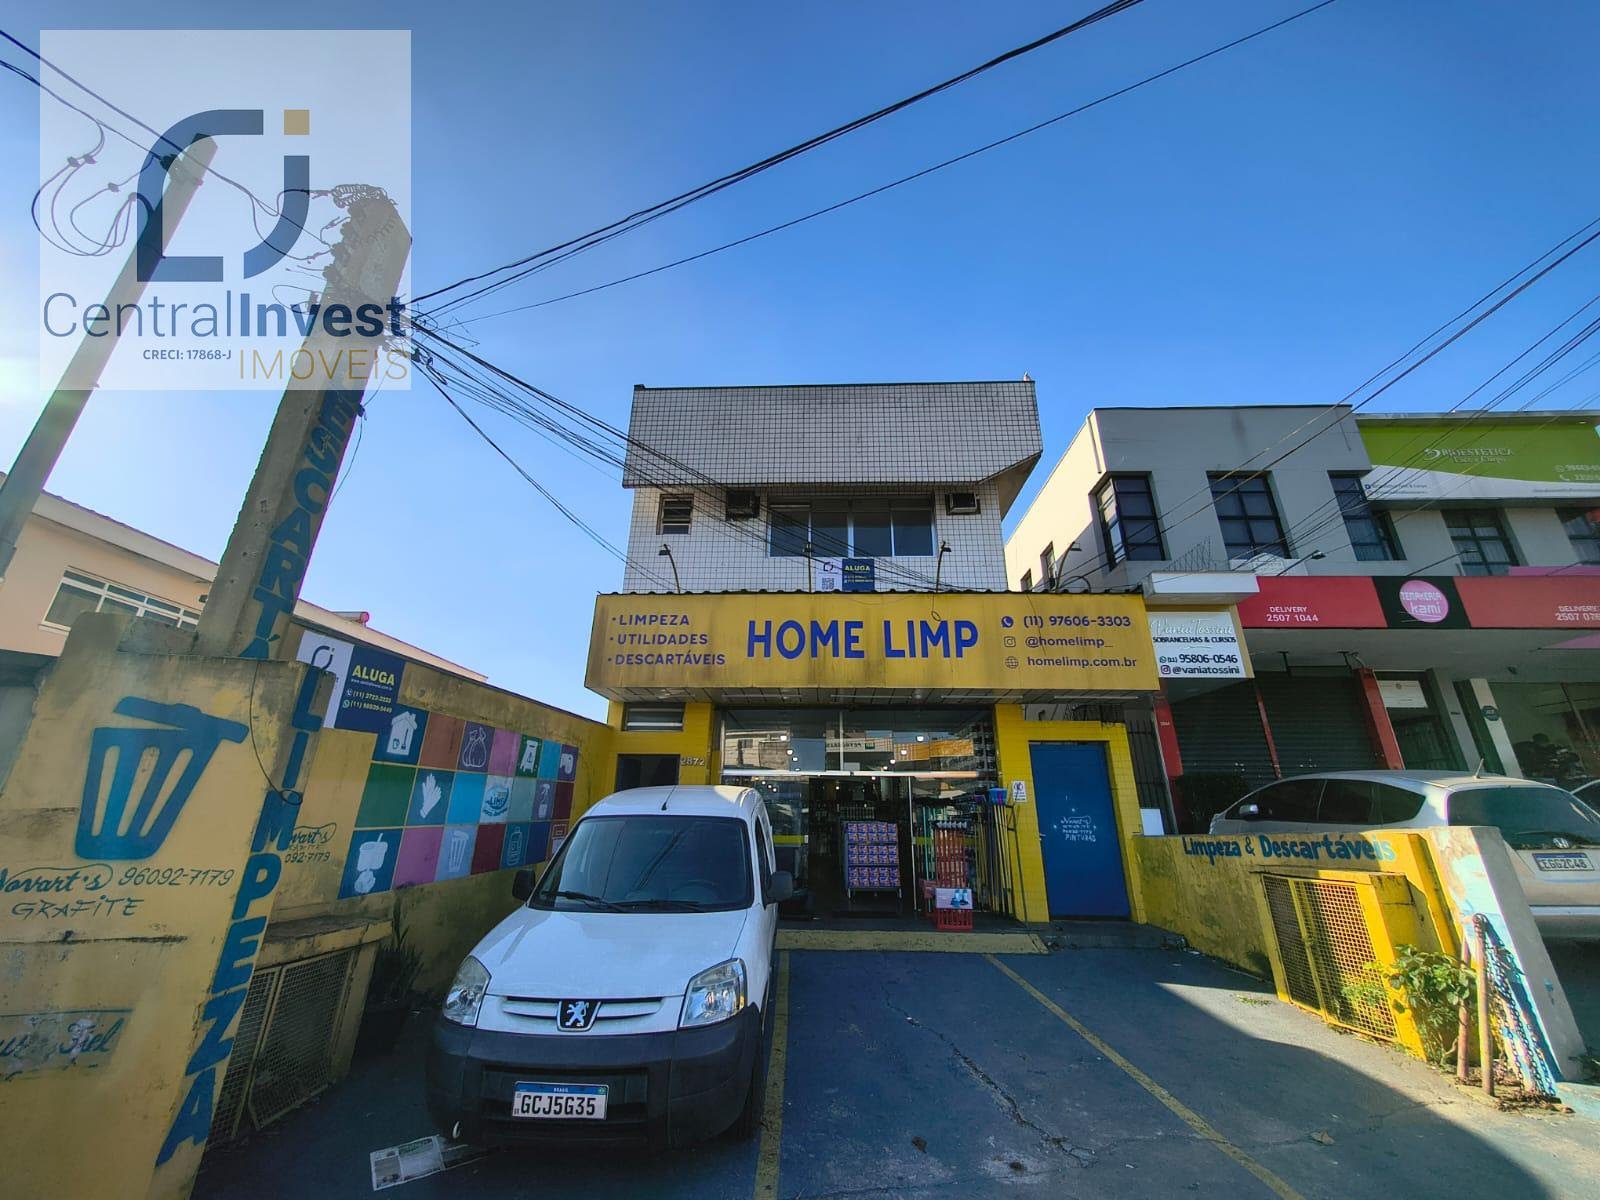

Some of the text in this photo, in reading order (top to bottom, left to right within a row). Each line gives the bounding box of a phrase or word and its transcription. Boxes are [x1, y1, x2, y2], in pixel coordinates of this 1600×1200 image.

[1410, 601, 1441, 614] kami
[618, 614, 690, 626] LIMPEZA
[1023, 615, 1132, 629] (11) 97606-3303
[1266, 614, 1319, 622] 2507 1044
[1555, 612, 1580, 621] 2507
[617, 633, 708, 646] UTILIDADES
[747, 619, 979, 660] HOME LIMP
[1025, 636, 1113, 648] @homelimp_
[615, 650, 726, 666] DESCARTÁVEIS
[1027, 656, 1137, 668] homelimp.com.br
[1179, 654, 1238, 664] 95806-0546
[352, 664, 395, 686] ALUGA
[1172, 665, 1240, 675] @vaniatossini
[1181, 833, 1397, 866] Limpeza & Descartáveis
[284, 851, 331, 863] 092-7179
[118, 866, 235, 887] 96092-7179
[11, 895, 145, 920] GRAFITE
[155, 666, 323, 1169] LIMPEZA
[520, 1094, 597, 1116] GCJ5G35
